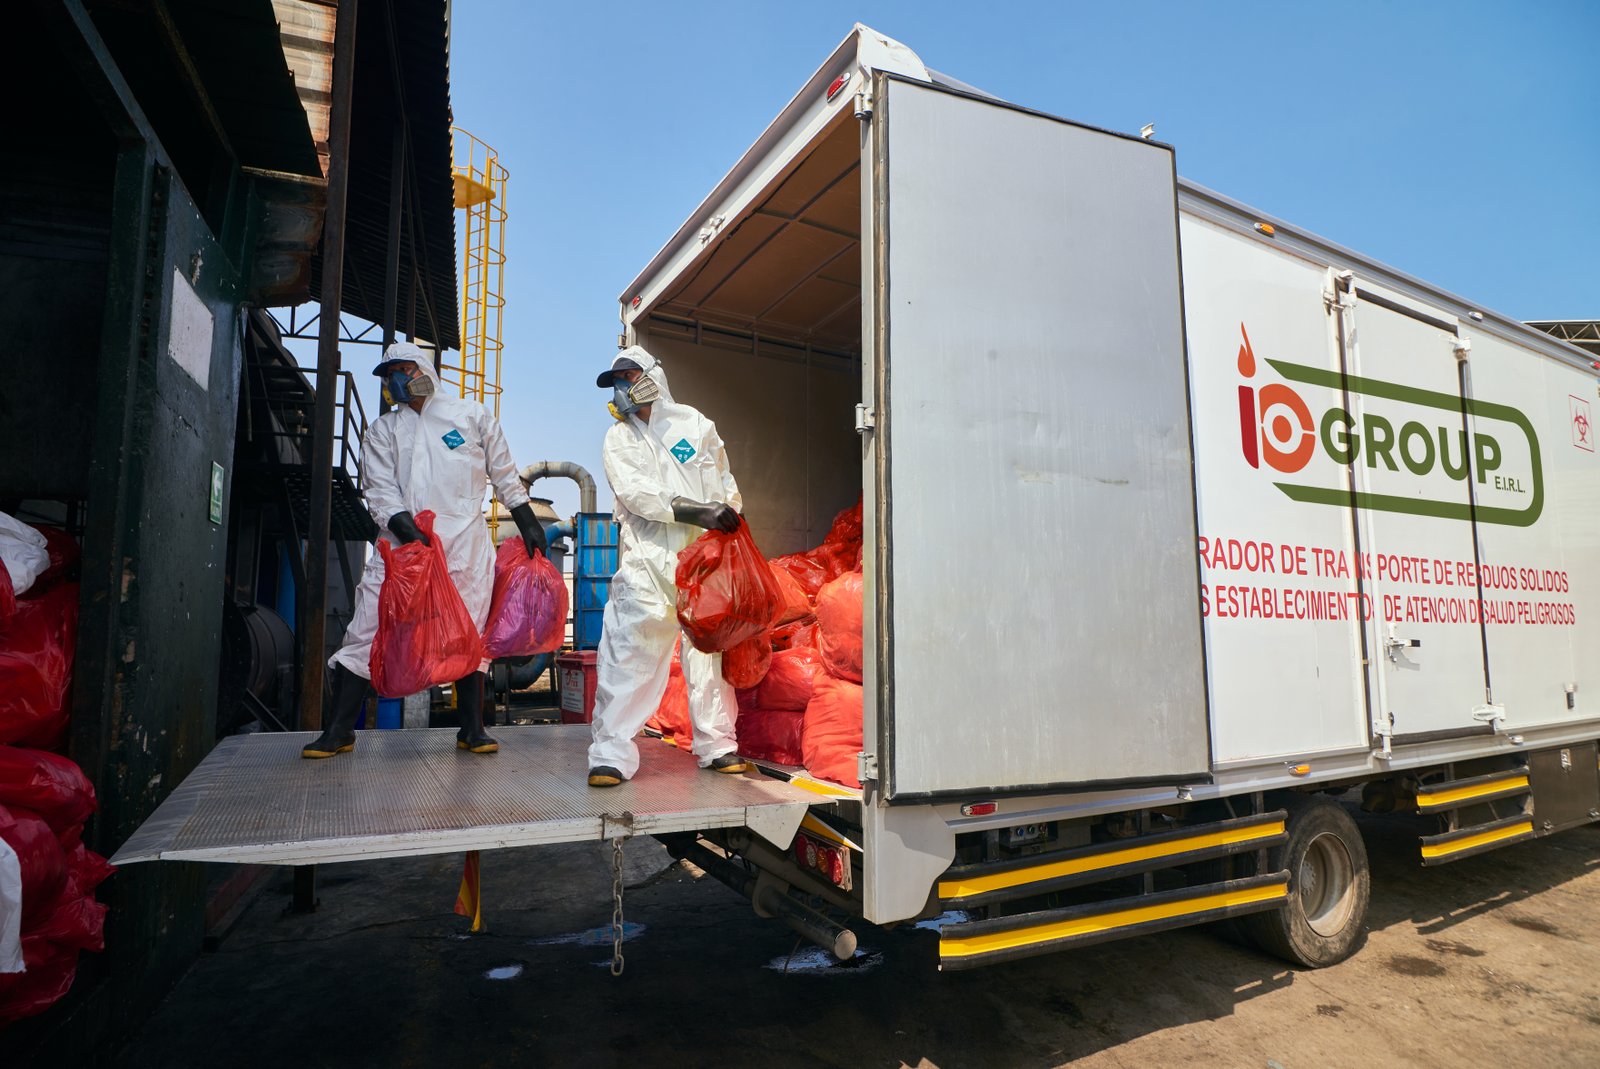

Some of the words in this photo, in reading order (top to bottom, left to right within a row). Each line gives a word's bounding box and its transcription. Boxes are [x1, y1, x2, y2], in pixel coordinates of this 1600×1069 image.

[1320, 407, 1502, 484] GROUP
[1494, 475, 1526, 493] E.I.R.L.
[1280, 544, 1308, 576] DE
[1433, 559, 1454, 586] DE
[1520, 567, 1569, 593] SOLIDOS
[1383, 594, 1403, 622] DE
[1406, 595, 1467, 624] ATENCION
[1483, 599, 1516, 625] SALUD
[1517, 601, 1576, 626] PELIGROSOS
